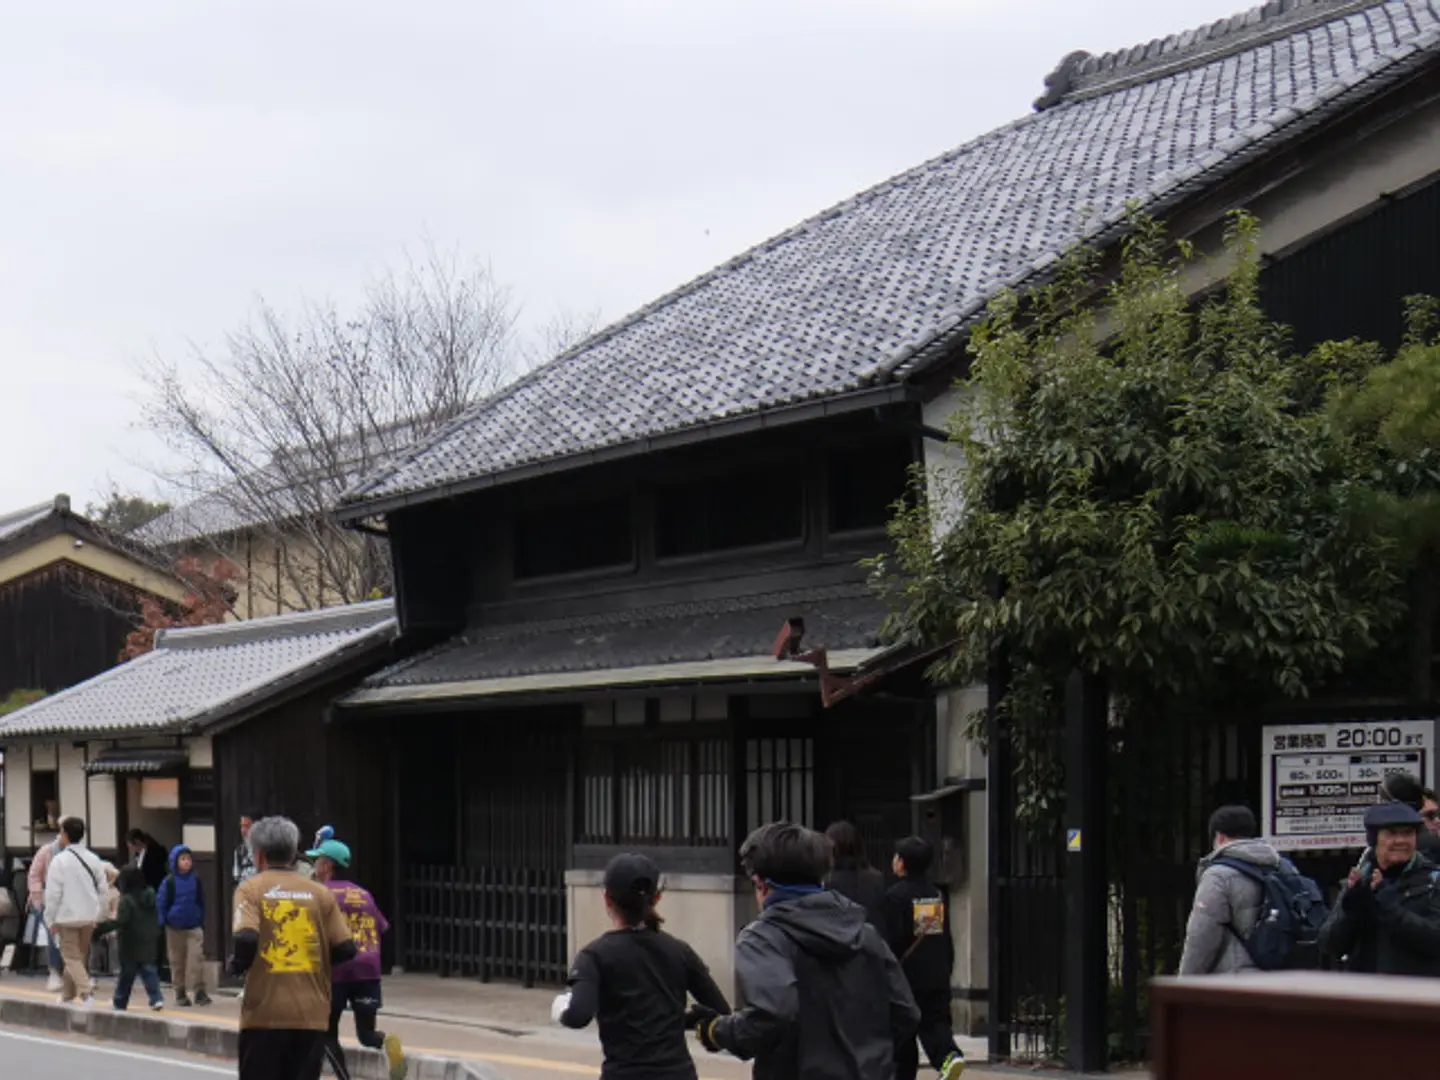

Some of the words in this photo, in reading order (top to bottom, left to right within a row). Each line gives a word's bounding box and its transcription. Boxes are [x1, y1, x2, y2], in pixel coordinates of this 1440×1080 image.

[1274, 734, 1326, 750] 営業時間
[1337, 727, 1401, 748] 20:00
